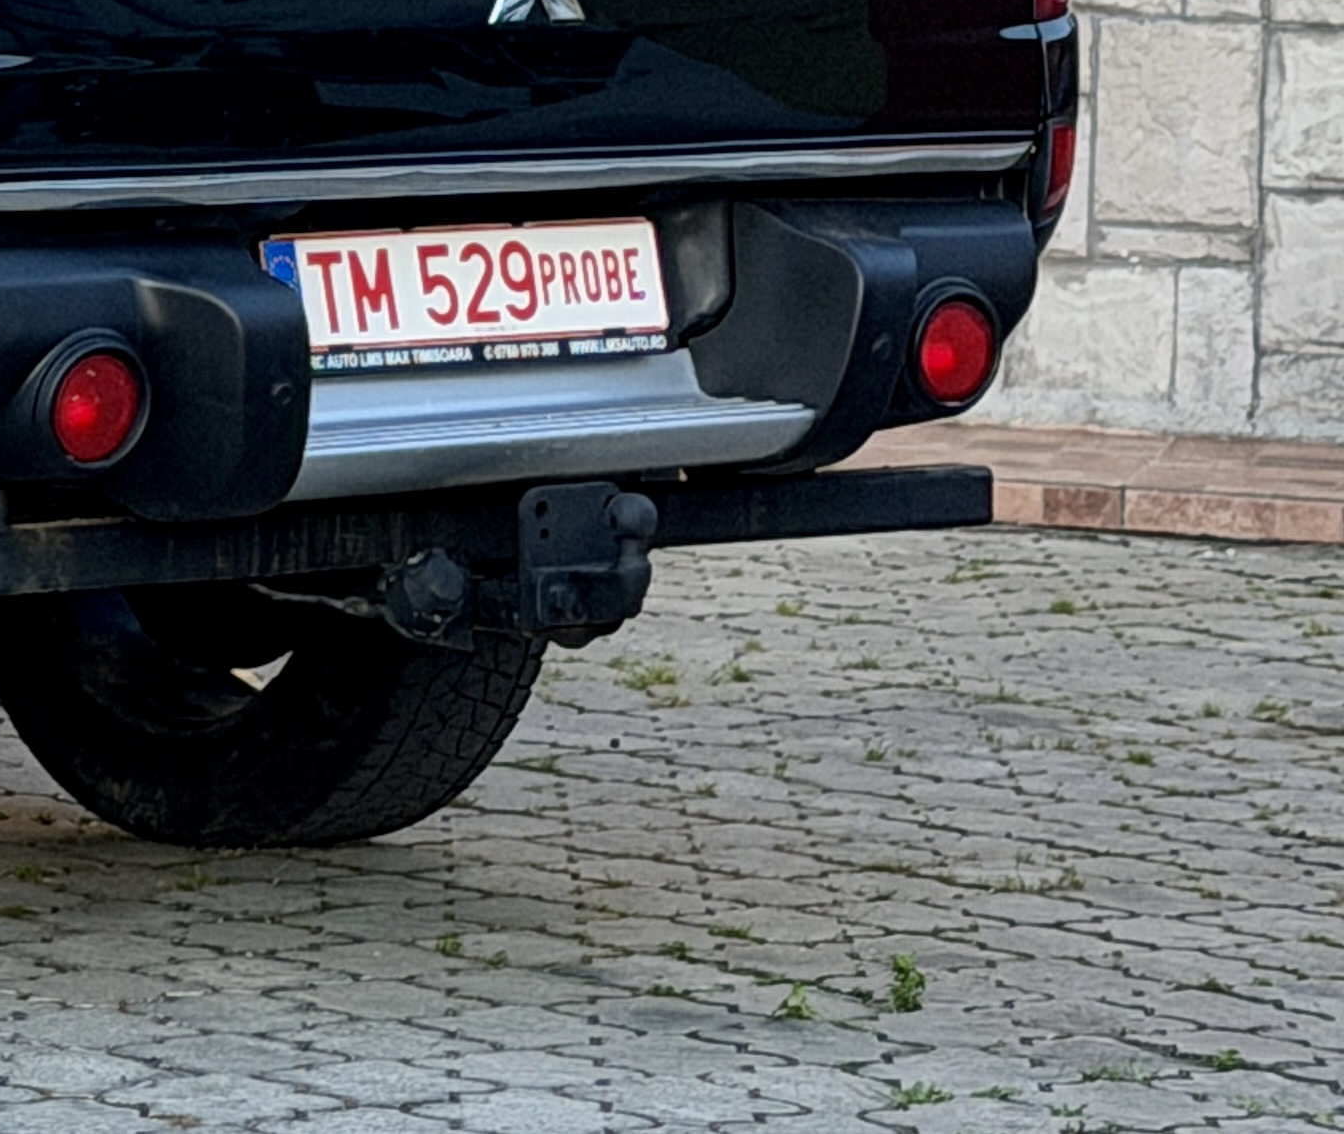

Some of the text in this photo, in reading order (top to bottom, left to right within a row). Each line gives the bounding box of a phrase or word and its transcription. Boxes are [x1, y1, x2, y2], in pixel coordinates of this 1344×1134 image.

[306, 240, 641, 334] TM 529 PROBE
